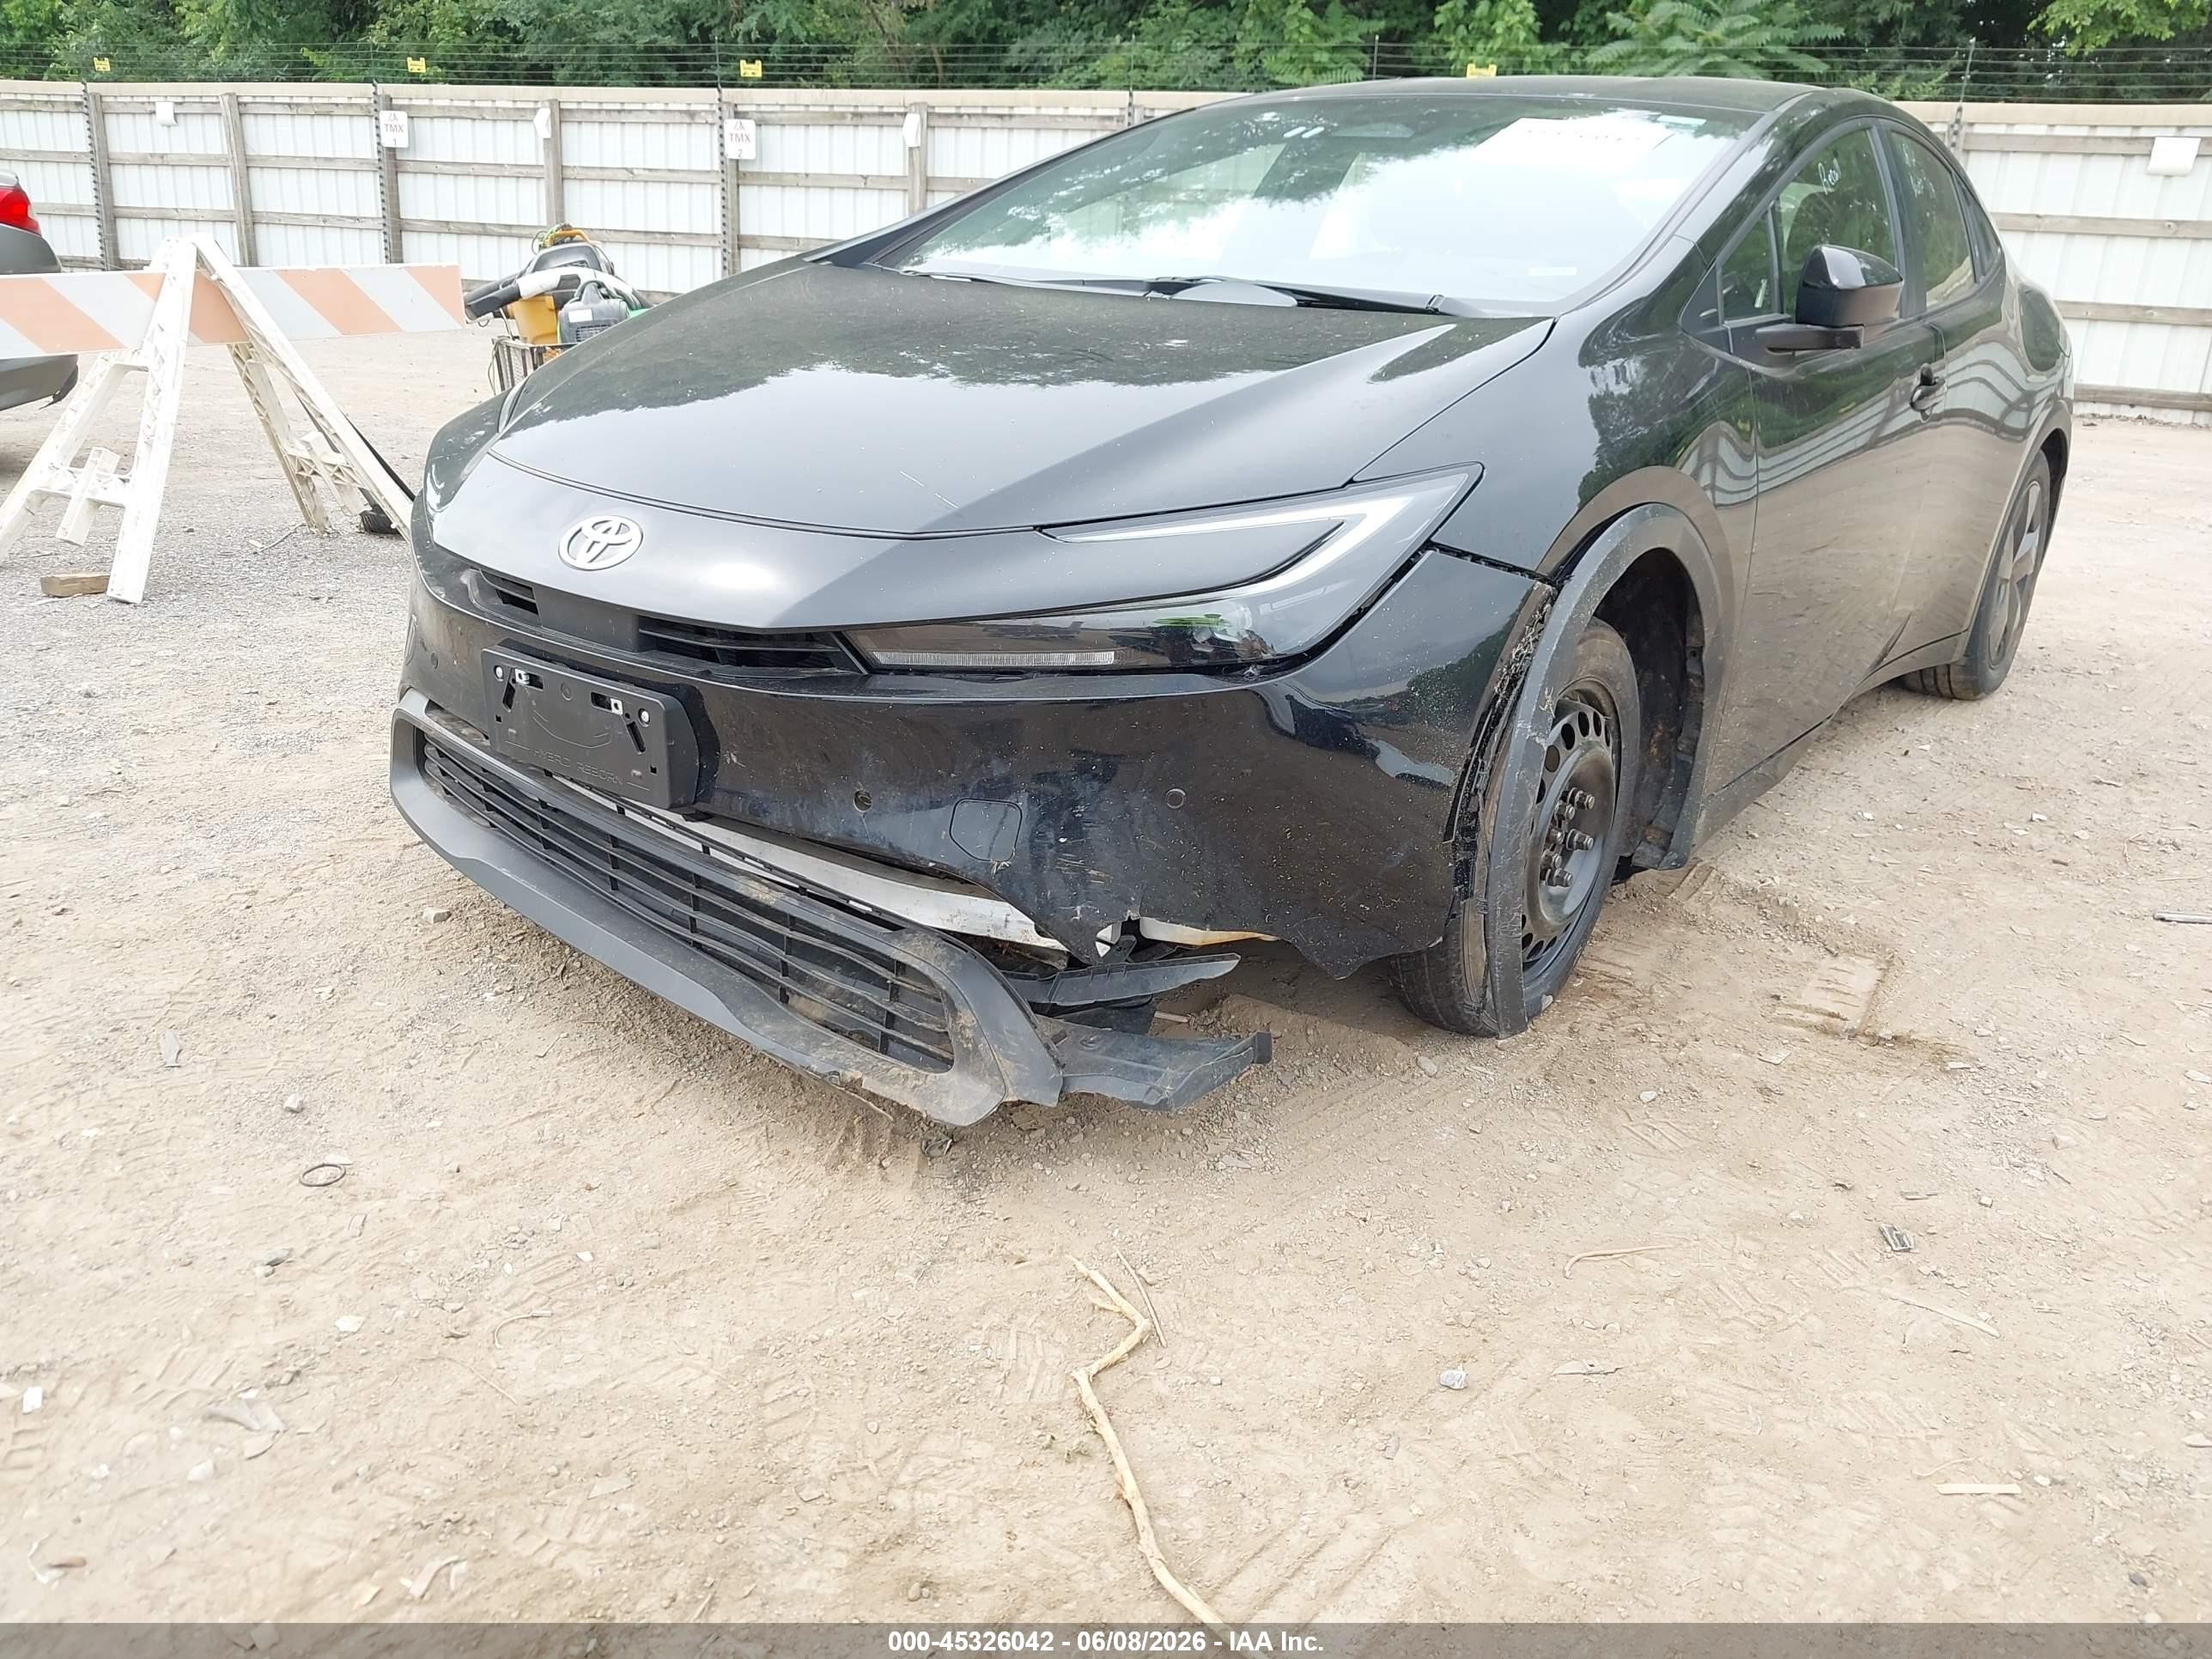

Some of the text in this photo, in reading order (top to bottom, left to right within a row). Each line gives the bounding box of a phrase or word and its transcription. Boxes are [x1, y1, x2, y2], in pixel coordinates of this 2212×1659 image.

[384, 124, 404, 133] TMX
[729, 133, 750, 143] TMX
[532, 748, 623, 786] HYBRD REBORN
